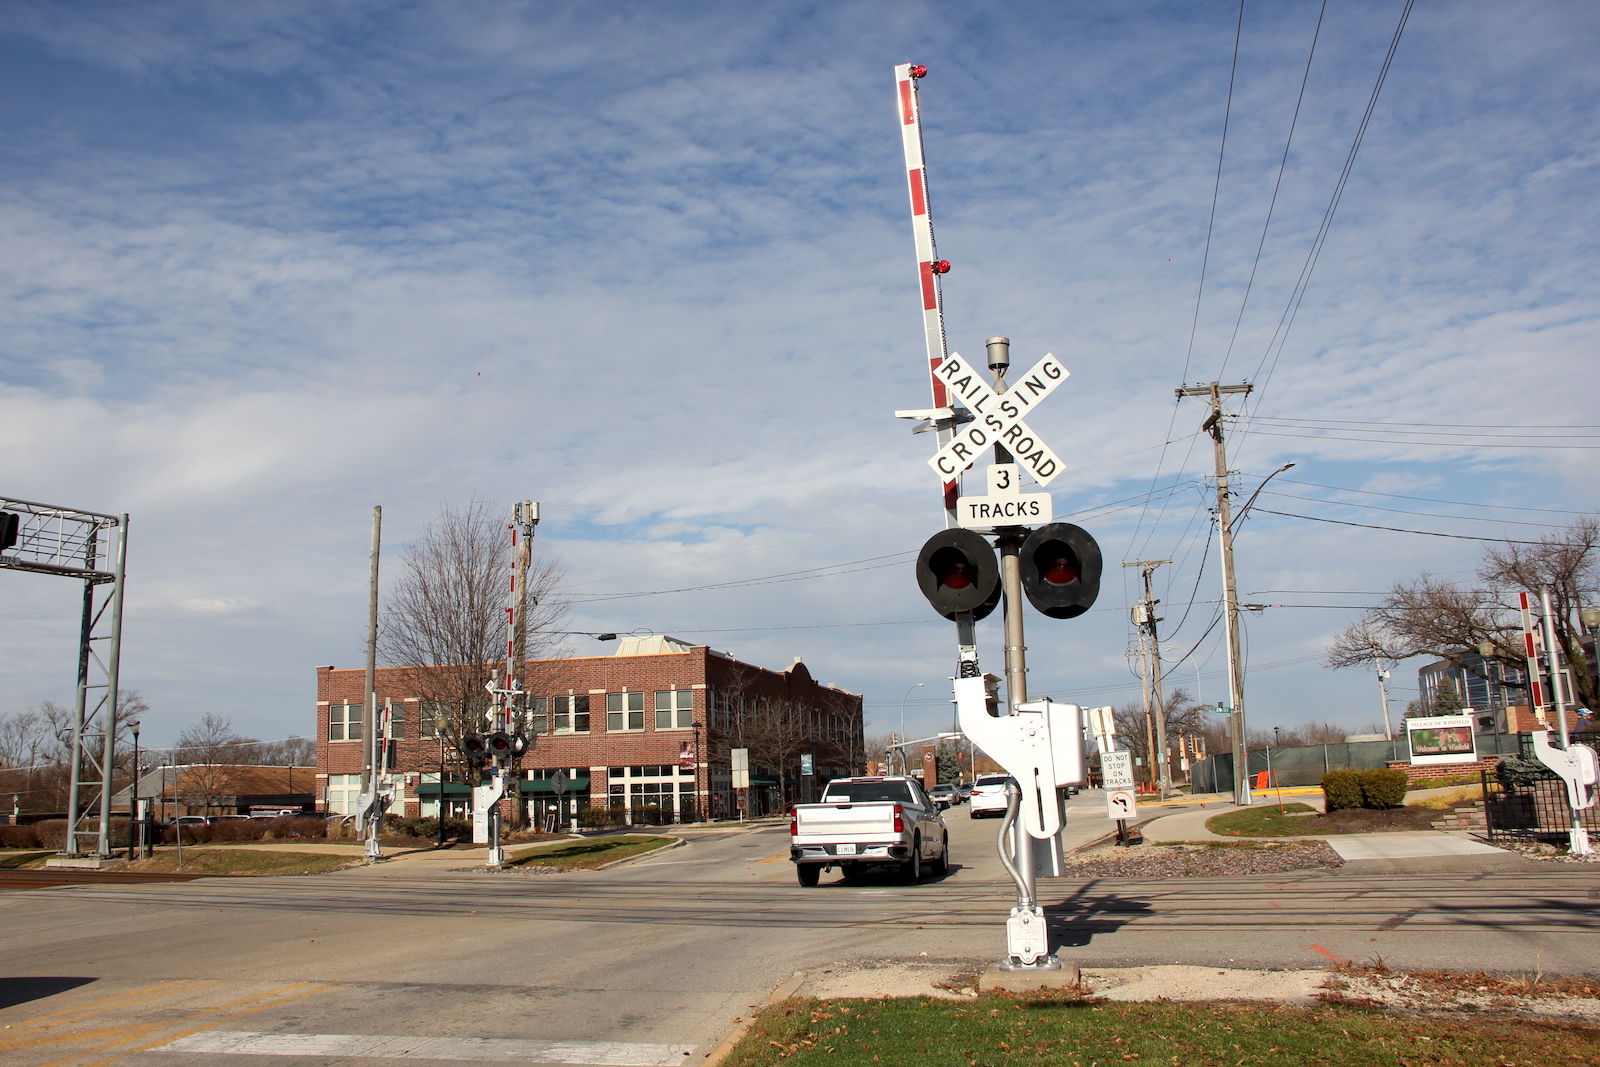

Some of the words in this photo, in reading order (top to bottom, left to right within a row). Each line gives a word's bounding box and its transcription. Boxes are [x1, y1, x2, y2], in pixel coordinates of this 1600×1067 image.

[937, 361, 1061, 475] CROSSING
[941, 359, 990, 414] RAIL
[1003, 423, 1056, 478] ROAD
[969, 501, 1040, 518] TRACKS
[996, 469, 1010, 489] 3
